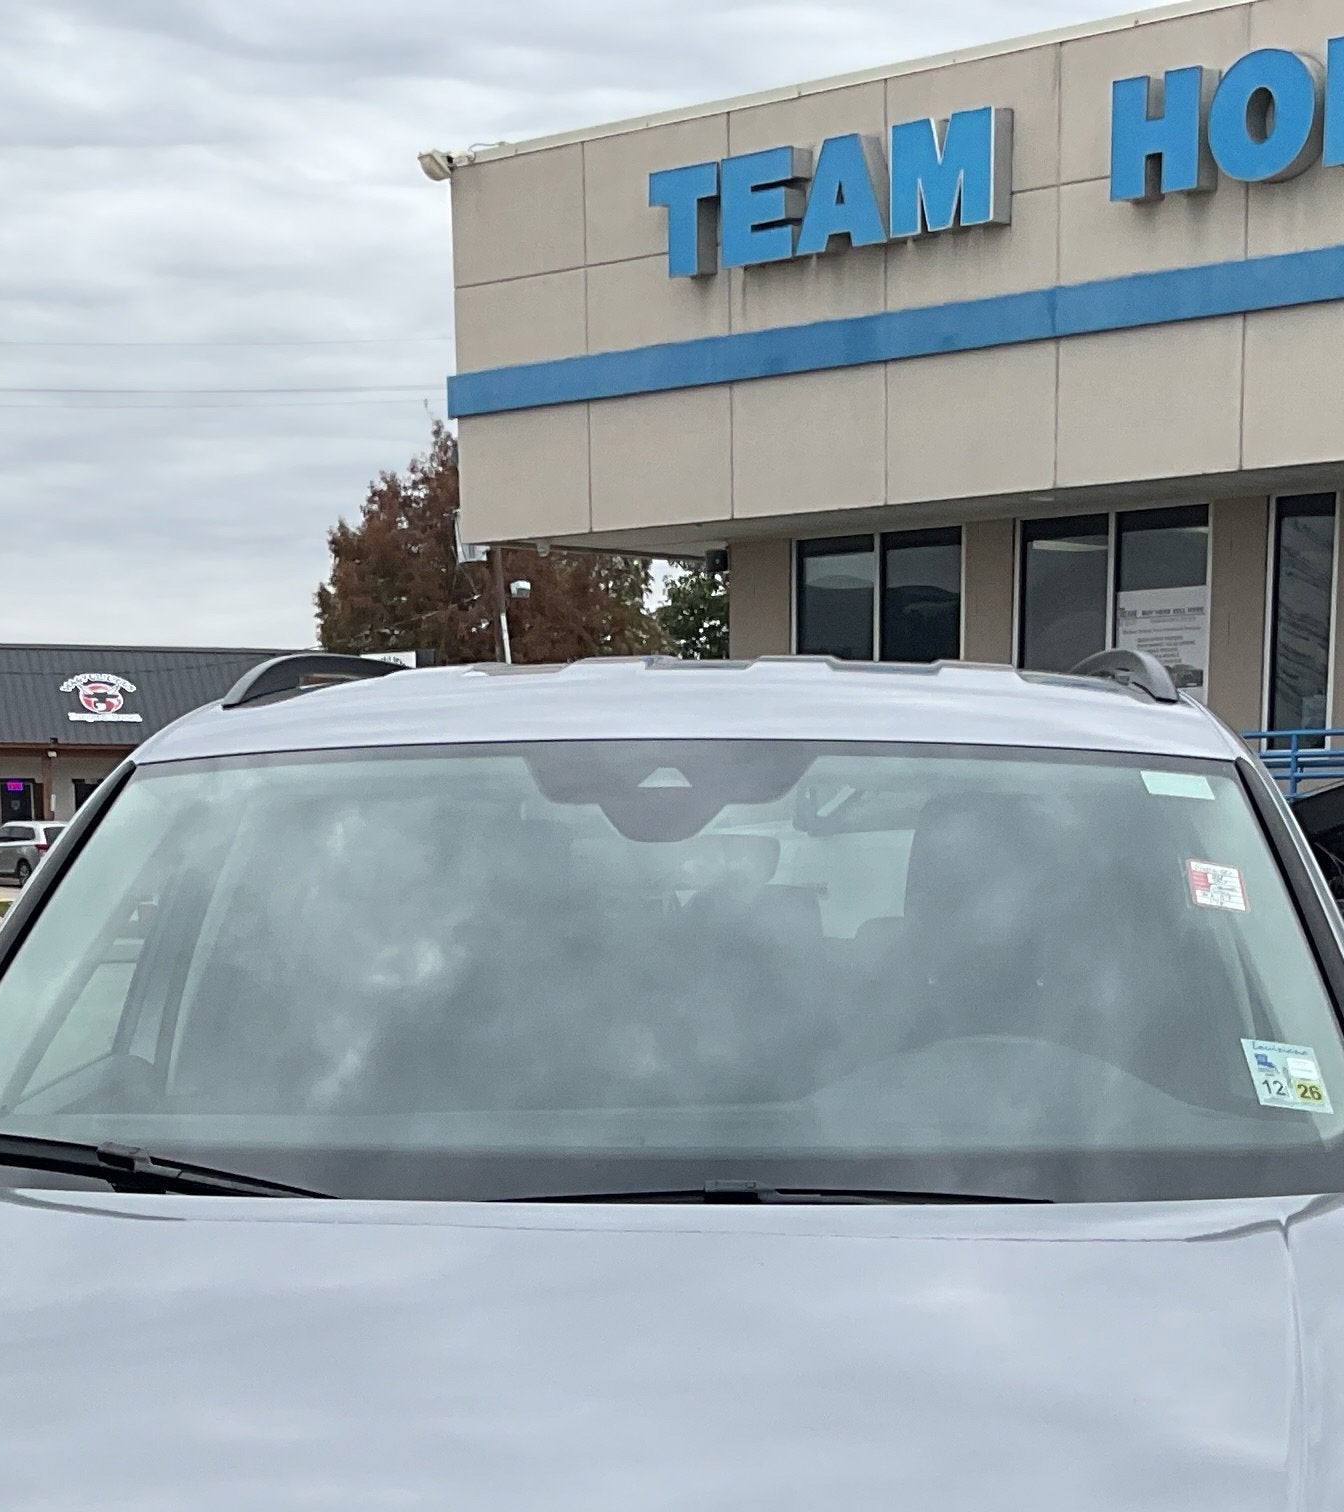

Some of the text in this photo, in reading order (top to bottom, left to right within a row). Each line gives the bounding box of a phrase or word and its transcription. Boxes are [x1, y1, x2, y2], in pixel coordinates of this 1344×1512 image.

[648, 105, 998, 280] TEAM
[1252, 1041, 1309, 1056] Louisiana
[1262, 1080, 1322, 1101] 12 26
